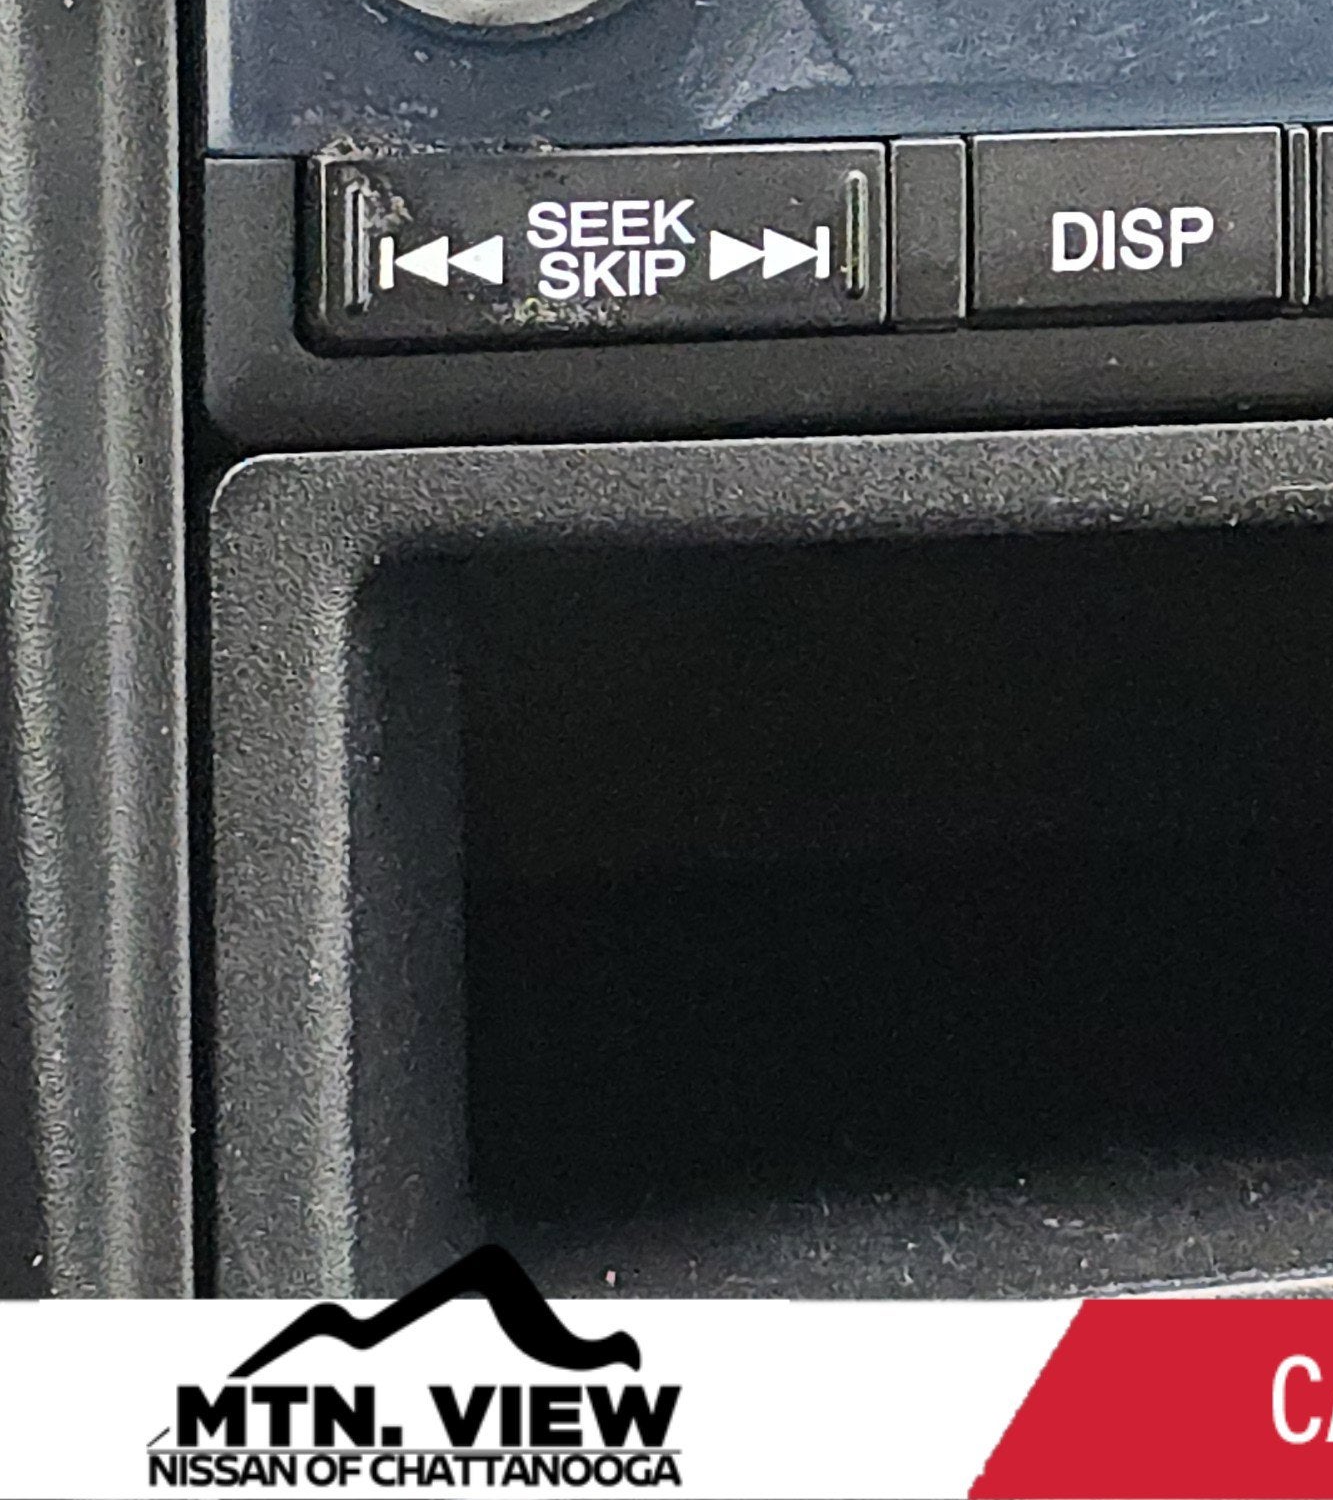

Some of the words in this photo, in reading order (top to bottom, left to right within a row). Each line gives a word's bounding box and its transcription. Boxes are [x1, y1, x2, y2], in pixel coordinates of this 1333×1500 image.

[526, 199, 696, 249] SEEK
[1051, 206, 1214, 273] DISP
[538, 249, 686, 300] SKIP
